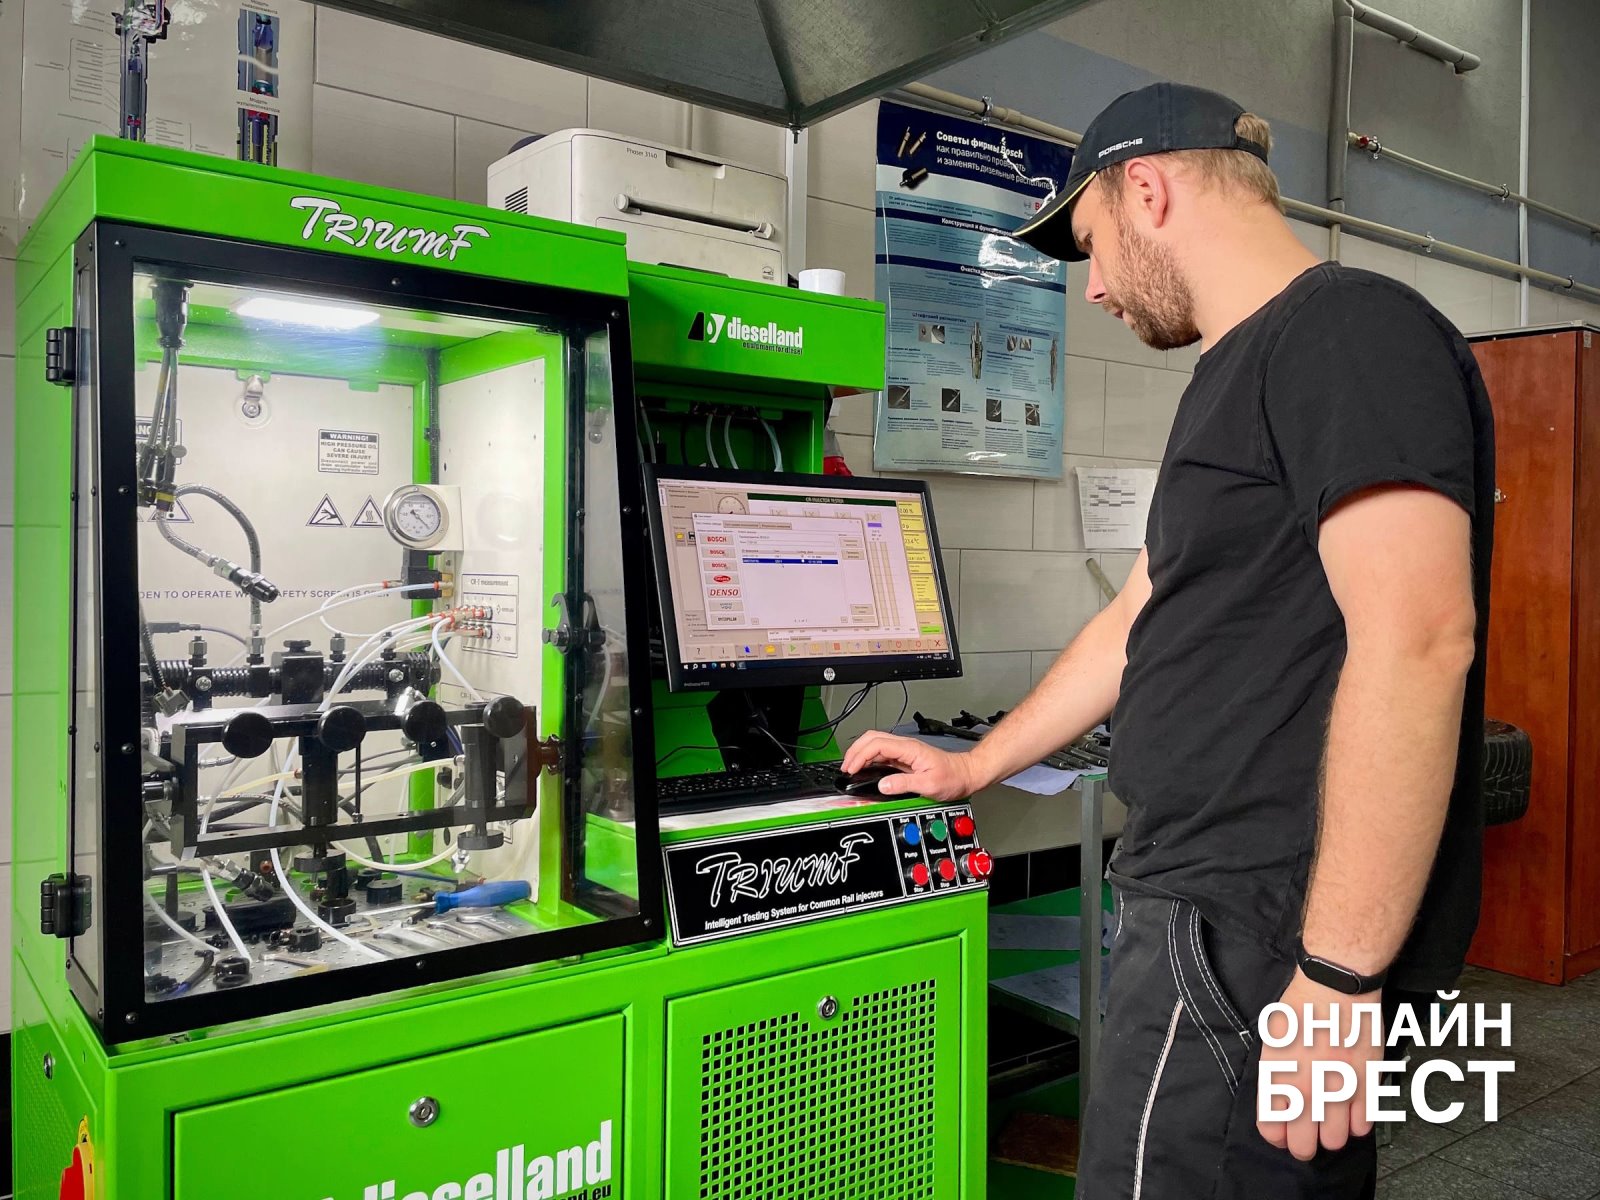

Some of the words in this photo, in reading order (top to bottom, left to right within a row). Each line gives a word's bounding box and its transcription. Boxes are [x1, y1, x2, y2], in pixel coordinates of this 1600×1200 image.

[627, 147, 644, 156] Phaser
[645, 151, 658, 159] 3140
[936, 131, 970, 146] Советы
[971, 137, 1000, 153] фирмы
[1000, 144, 1024, 159] Bosch
[936, 145, 951, 154] как
[951, 147, 992, 162] правильно
[1098, 138, 1144, 158] PORSCHE
[937, 156, 943, 164] и
[943, 158, 981, 171] заменять
[980, 165, 1016, 181] дизельные
[289, 195, 492, 262] TRIUMF
[726, 316, 803, 348] dieselland
[776, 345, 784, 353] for
[784, 347, 803, 355] diesel
[329, 433, 369, 442] WARNING!
[165, 591, 179, 599] TO
[182, 590, 232, 599] OPERATE
[709, 588, 739, 596] DENSO
[929, 847, 947, 855] Vacuum
[954, 843, 975, 851] Emergency
[695, 831, 875, 908] TRIUMF
[704, 912, 742, 931] Intelligent
[743, 910, 770, 923] Testing
[770, 905, 798, 919] System
[798, 902, 809, 912] for
[809, 897, 841, 910] Common
[841, 893, 855, 904] Rail
